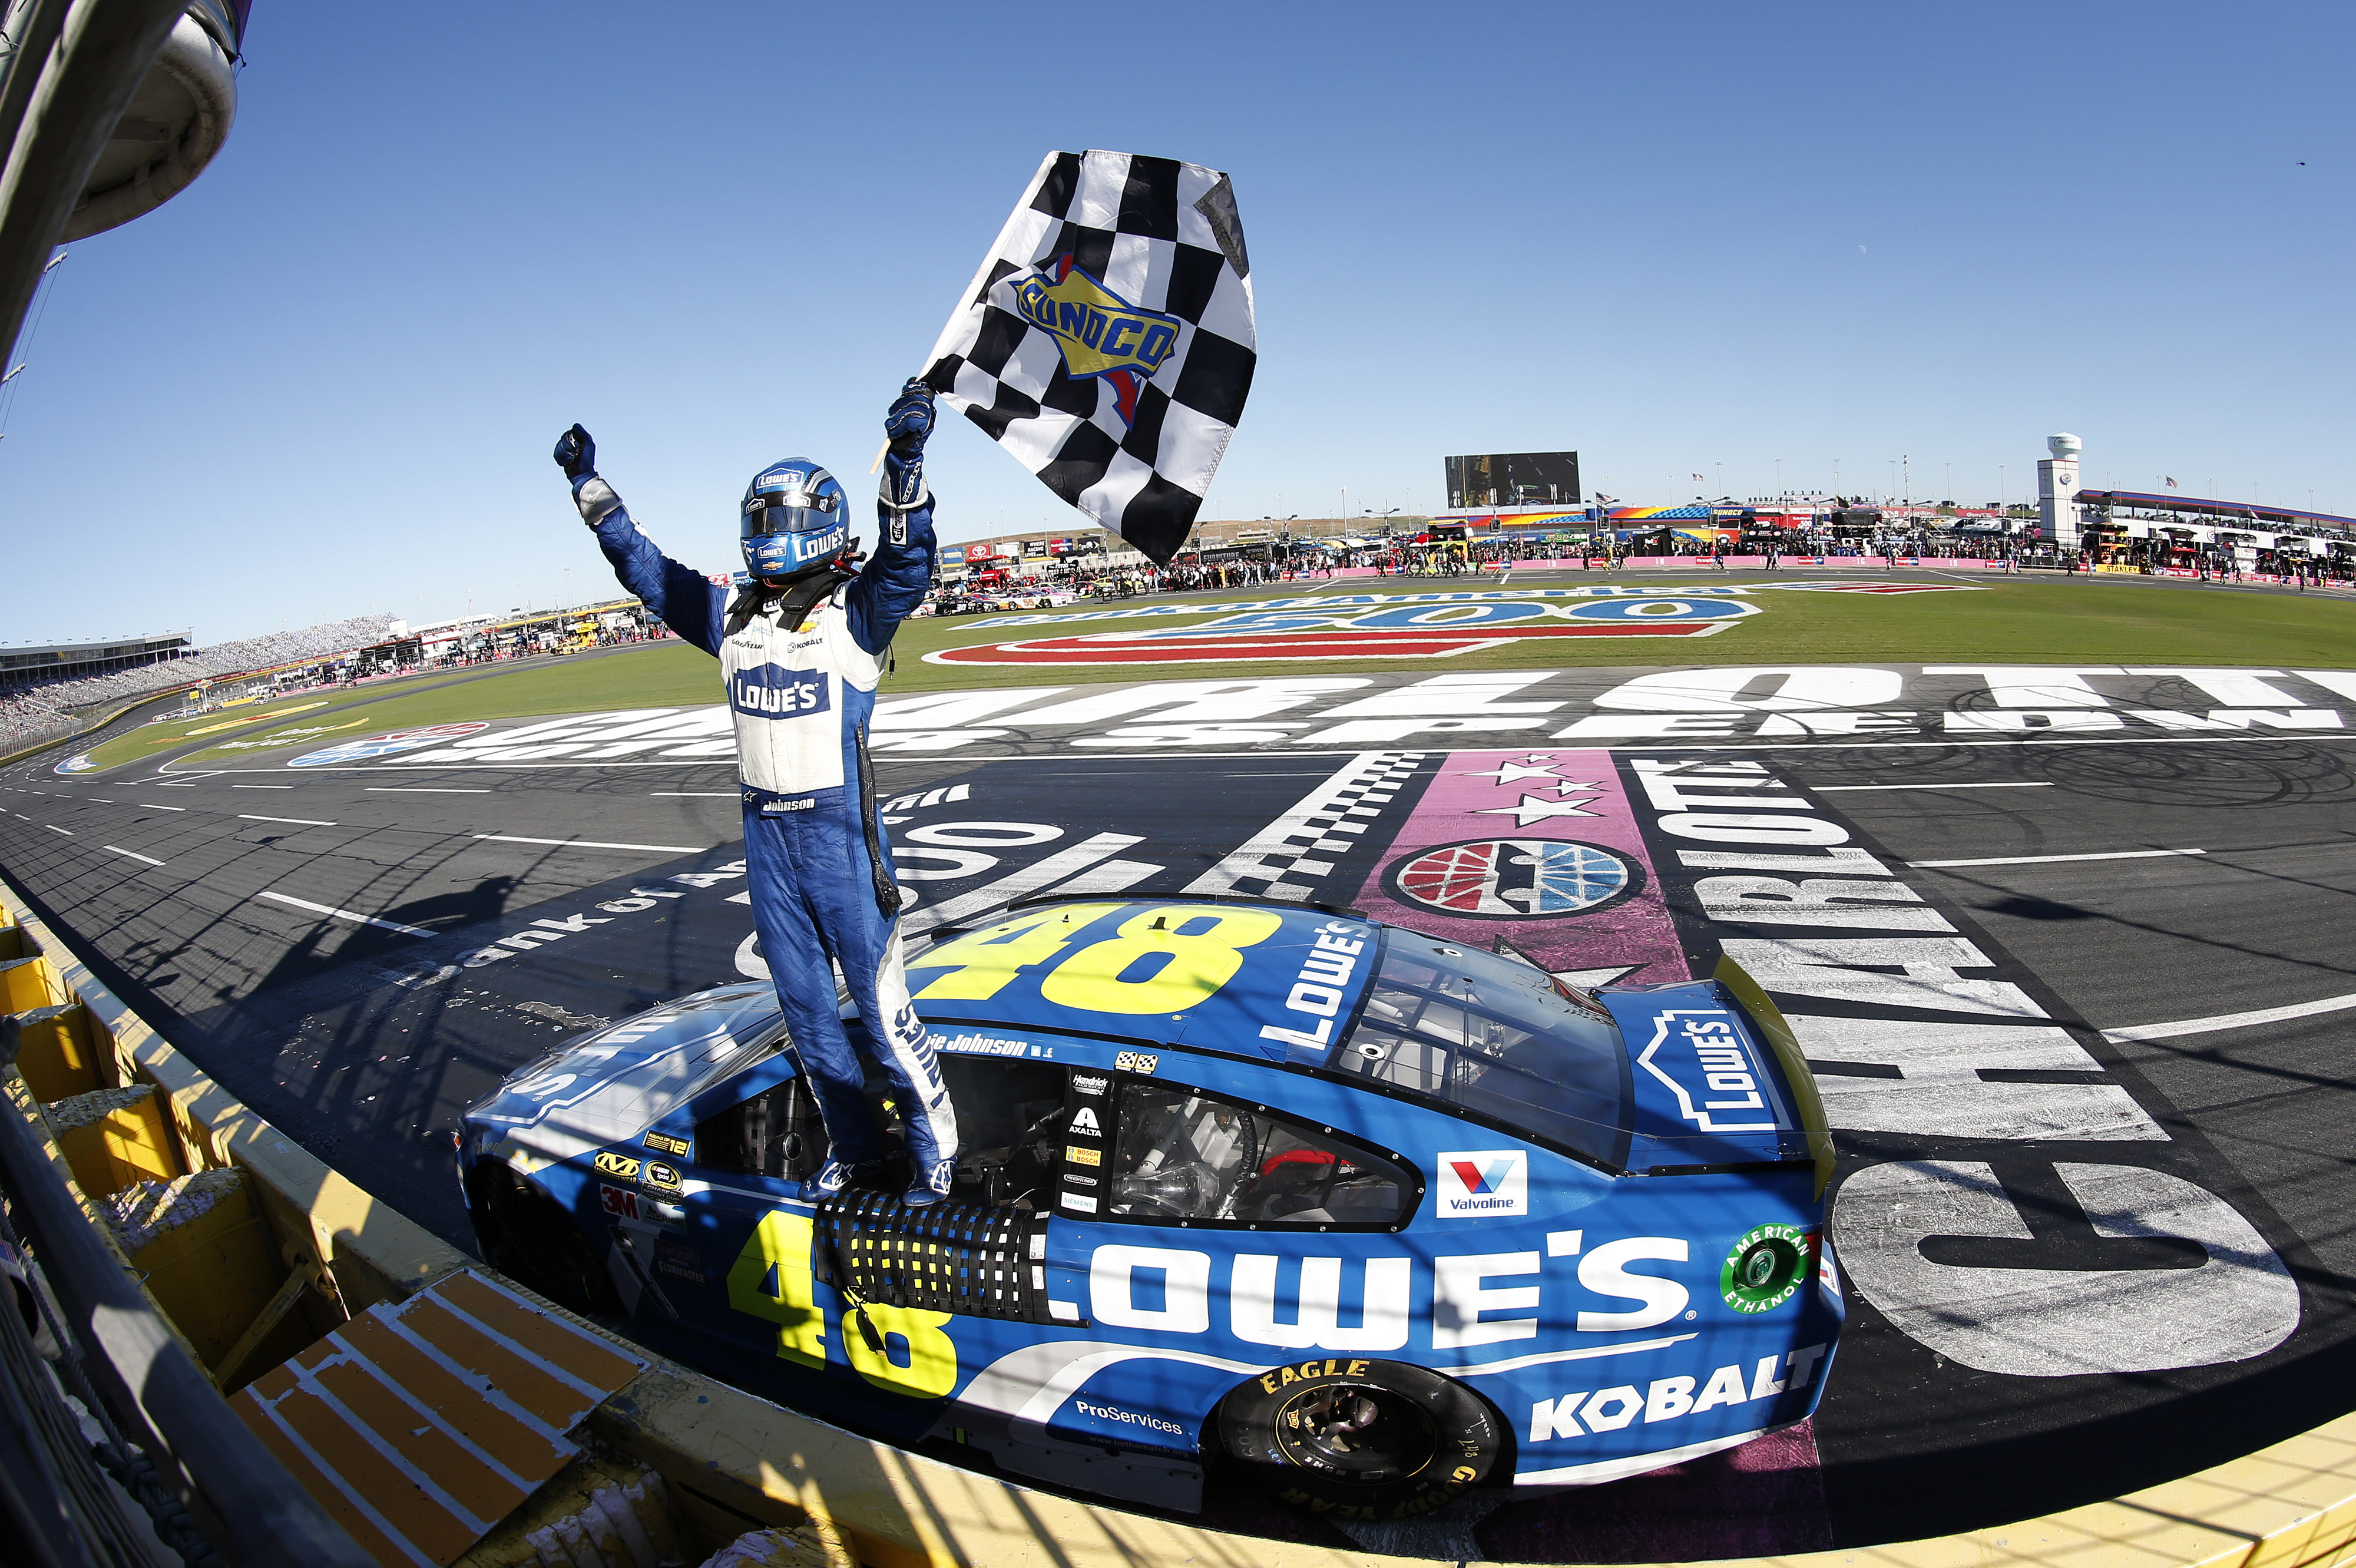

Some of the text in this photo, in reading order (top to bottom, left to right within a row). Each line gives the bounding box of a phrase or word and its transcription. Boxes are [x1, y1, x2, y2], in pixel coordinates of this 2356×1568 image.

[1020, 282, 1174, 366] SUNOCO
[760, 472, 800, 485] LOWE'S
[747, 501, 763, 511] LOWE'S
[760, 547, 783, 555] LOWE'S
[793, 527, 845, 562] LOWE'S
[1078, 587, 1087, 596] 5
[1305, 587, 1749, 609] America
[957, 603, 967, 611] 30
[1093, 597, 1763, 640] 500
[732, 639, 763, 650] GOODYEAR
[797, 638, 823, 649] KOBALT
[737, 678, 817, 713] LOWE'S
[1070, 709, 2347, 746] SPEEDW
[763, 798, 815, 812] Johnson
[905, 901, 1283, 1015] 48
[1258, 920, 1372, 1051] LOWE'S
[947, 1033, 1027, 1056] Johnson
[1629, 759, 2301, 1377] CHARLOTTE
[1680, 1021, 1765, 1109] LOWE'S
[1073, 1074, 1108, 1088] Hendrick
[1068, 1126, 1102, 1137] AXALTA
[669, 1140, 688, 1155] 12
[1077, 1149, 1099, 1157] BOSCH
[1076, 1156, 1098, 1165] BOSCH
[594, 1166, 637, 1185] MECHANIX WEAR
[657, 1172, 670, 1181] Sprint
[1066, 1175, 1094, 1185] FREIGHTLINER
[643, 1188, 665, 1199] SPRINT
[666, 1193, 680, 1202] CUP
[647, 1185, 671, 1195] CHASE
[601, 1186, 639, 1220] 3M
[1064, 1197, 1093, 1208] SIEMENS
[1450, 1197, 1514, 1209] Valvoline
[666, 1215, 684, 1228] LIGHT
[1726, 1226, 1810, 1268] AMERICAN
[658, 1261, 705, 1284] FLOWMASTER
[1048, 1229, 1690, 1351] OWE'S
[1724, 1276, 1805, 1312] ETHANOL
[726, 1209, 958, 1399] 48
[1260, 1359, 1371, 1395] EAGLE
[1529, 1343, 1826, 1443] KOBALT
[1076, 1400, 1183, 1435] ProServices
[1088, 1435, 1189, 1458] www.bethematch.org
